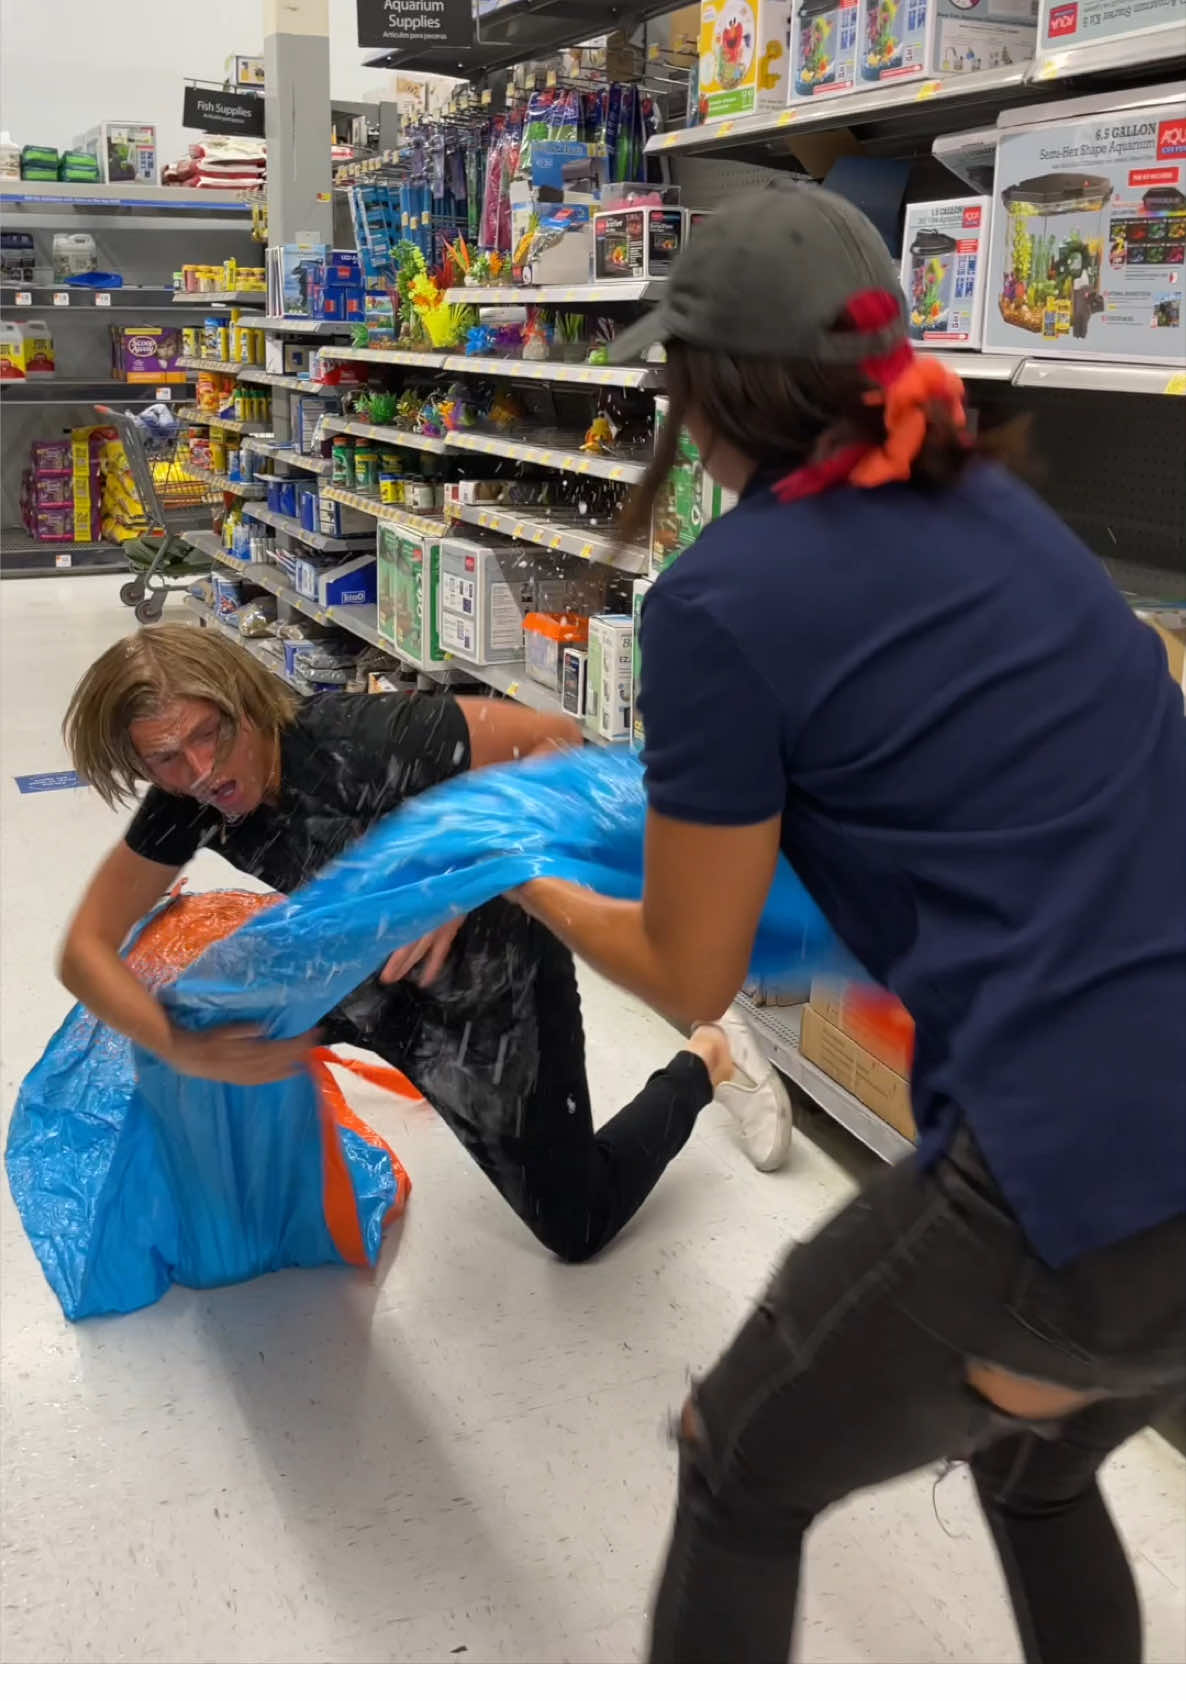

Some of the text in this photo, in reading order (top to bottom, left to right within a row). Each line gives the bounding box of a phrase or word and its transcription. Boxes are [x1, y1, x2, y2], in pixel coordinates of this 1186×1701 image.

[384, 0, 444, 12] Aquarium
[388, 14, 441, 30] Supplies
[197, 100, 253, 118] Fish Supplies
[1111, 122, 1157, 139] GALLON
[1080, 143, 1107, 158] Shape
[1108, 139, 1156, 156] Aquarium
